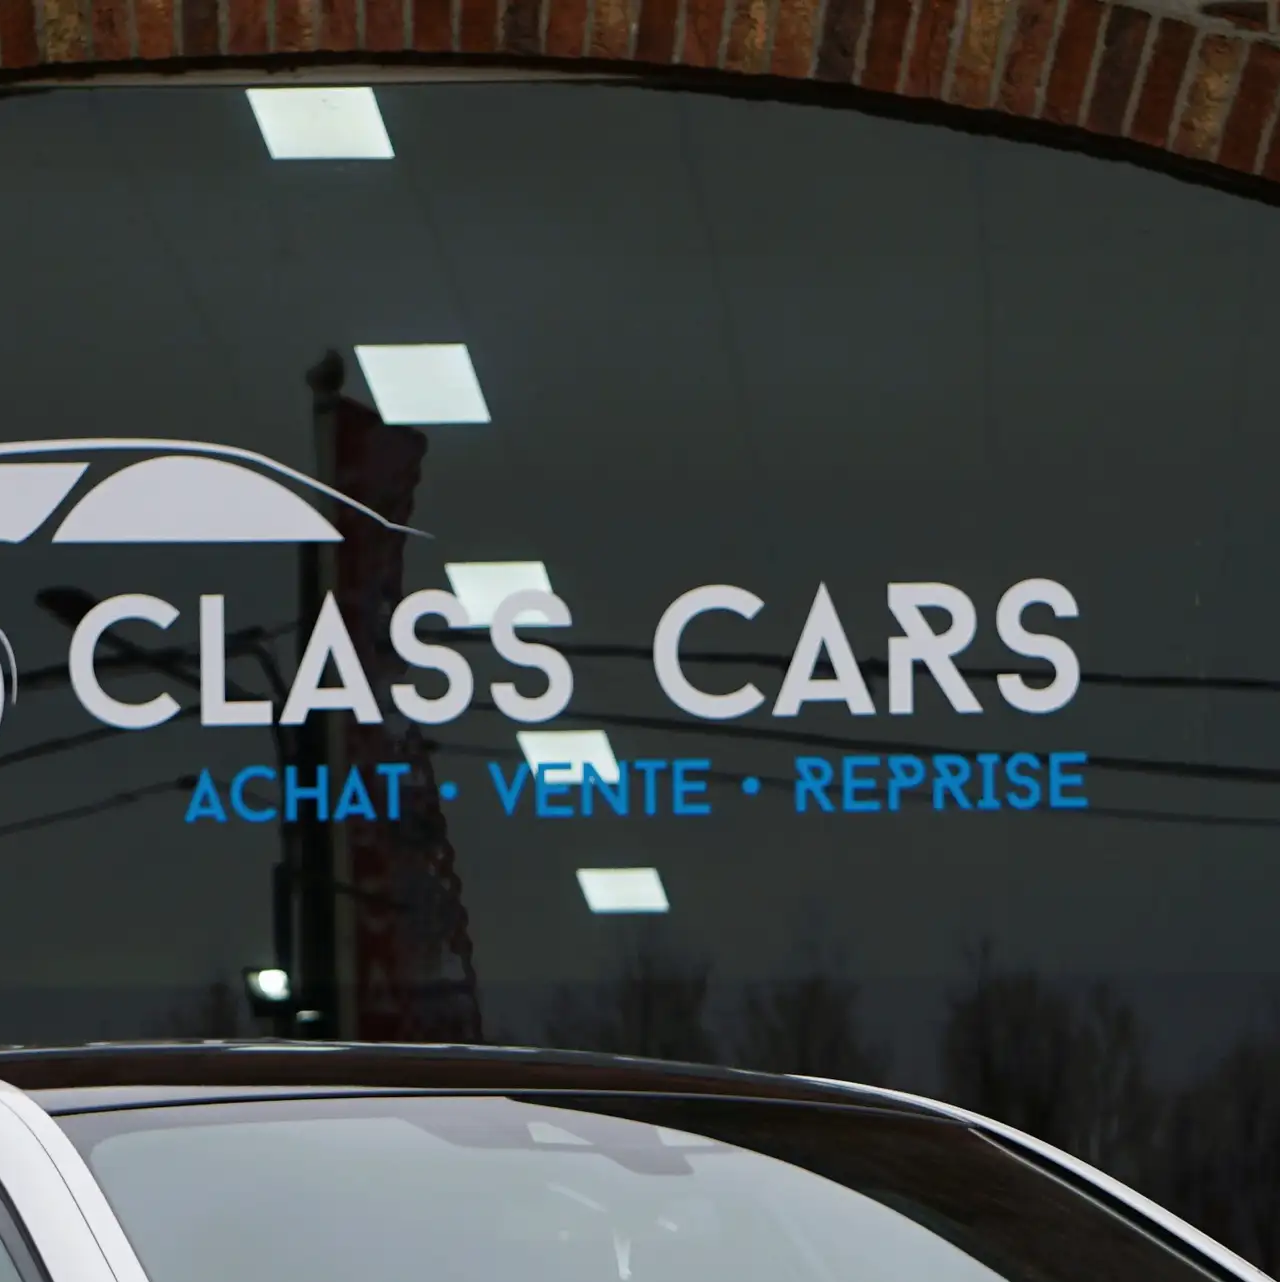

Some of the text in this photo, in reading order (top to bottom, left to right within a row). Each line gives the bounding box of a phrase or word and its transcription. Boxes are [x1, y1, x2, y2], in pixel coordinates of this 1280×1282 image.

[69, 578, 1080, 730] CLASS CARS
[184, 752, 1089, 823] ACHAT VENTE REPRISE
